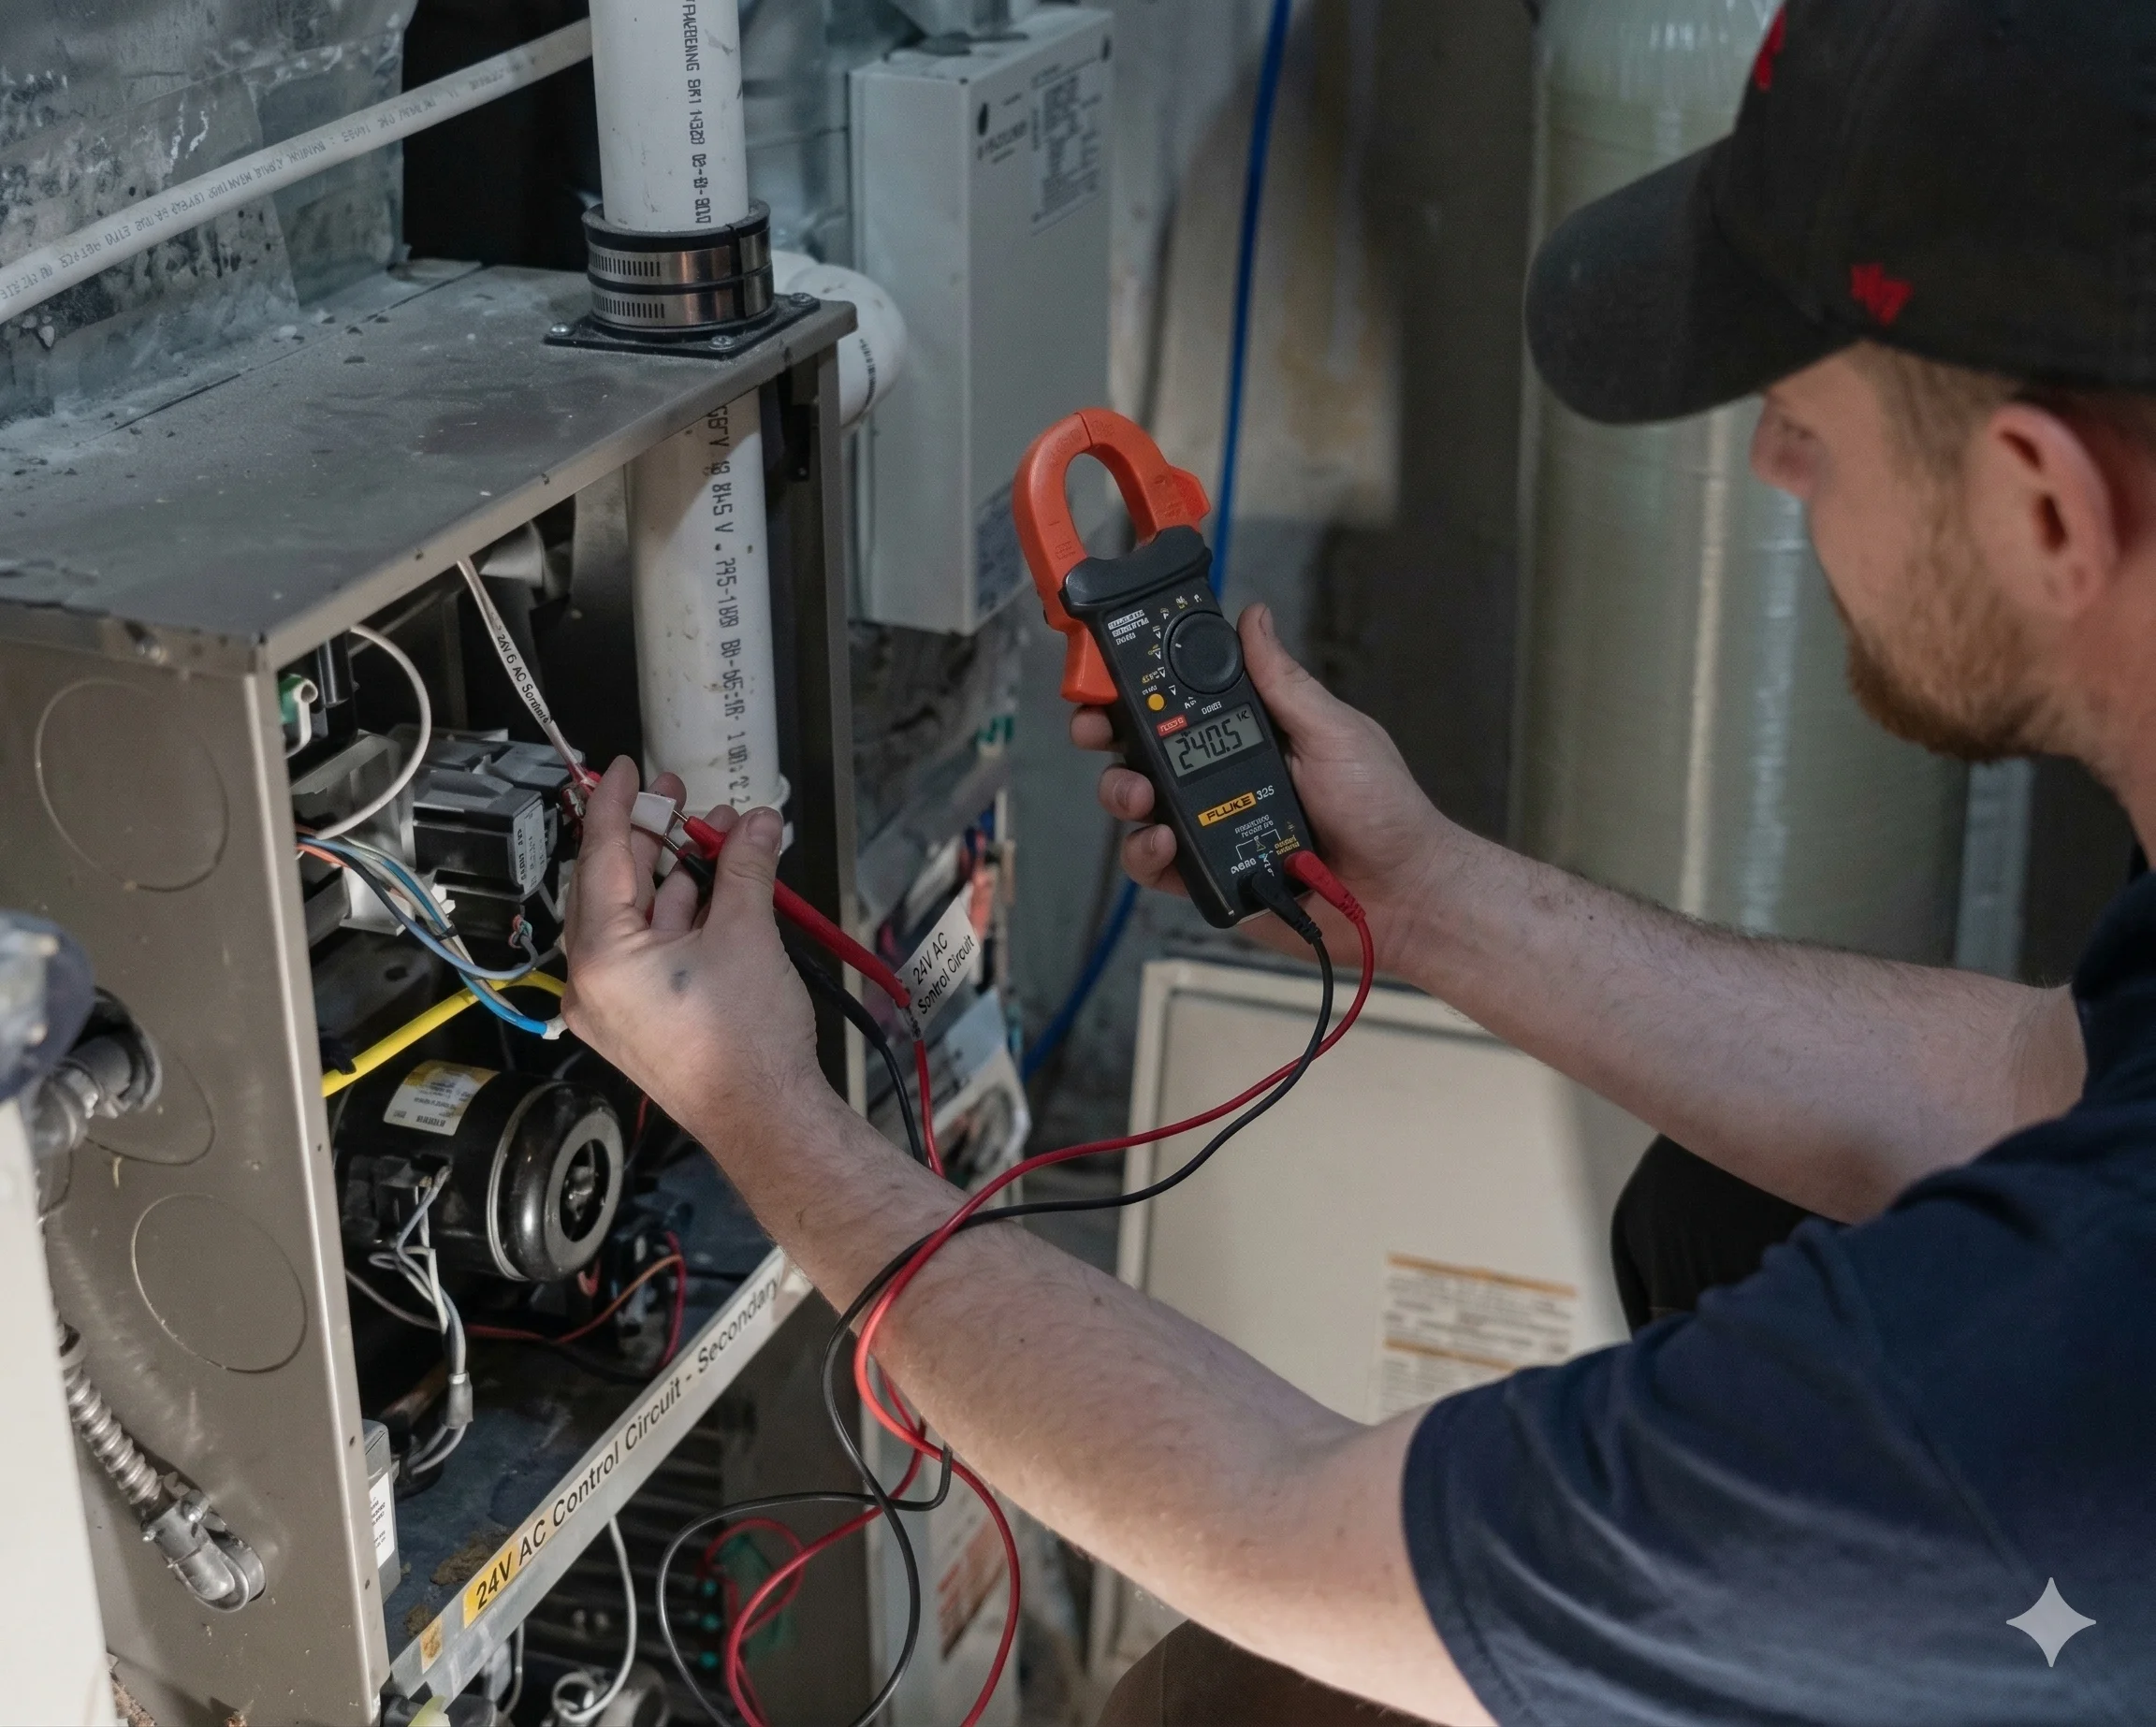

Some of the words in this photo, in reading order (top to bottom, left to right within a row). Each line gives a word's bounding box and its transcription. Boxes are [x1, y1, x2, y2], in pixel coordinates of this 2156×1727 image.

[1175, 718, 1243, 770] 240.5
[1206, 795, 1253, 821] FLUKE
[912, 950, 933, 986] 24V
[932, 932, 948, 961] AC
[947, 935, 975, 973] Circuit
[475, 1551, 513, 1611] 24V
[518, 1518, 546, 1566] AC
[552, 1440, 619, 1527] Control
[625, 1376, 681, 1451] Circuit
